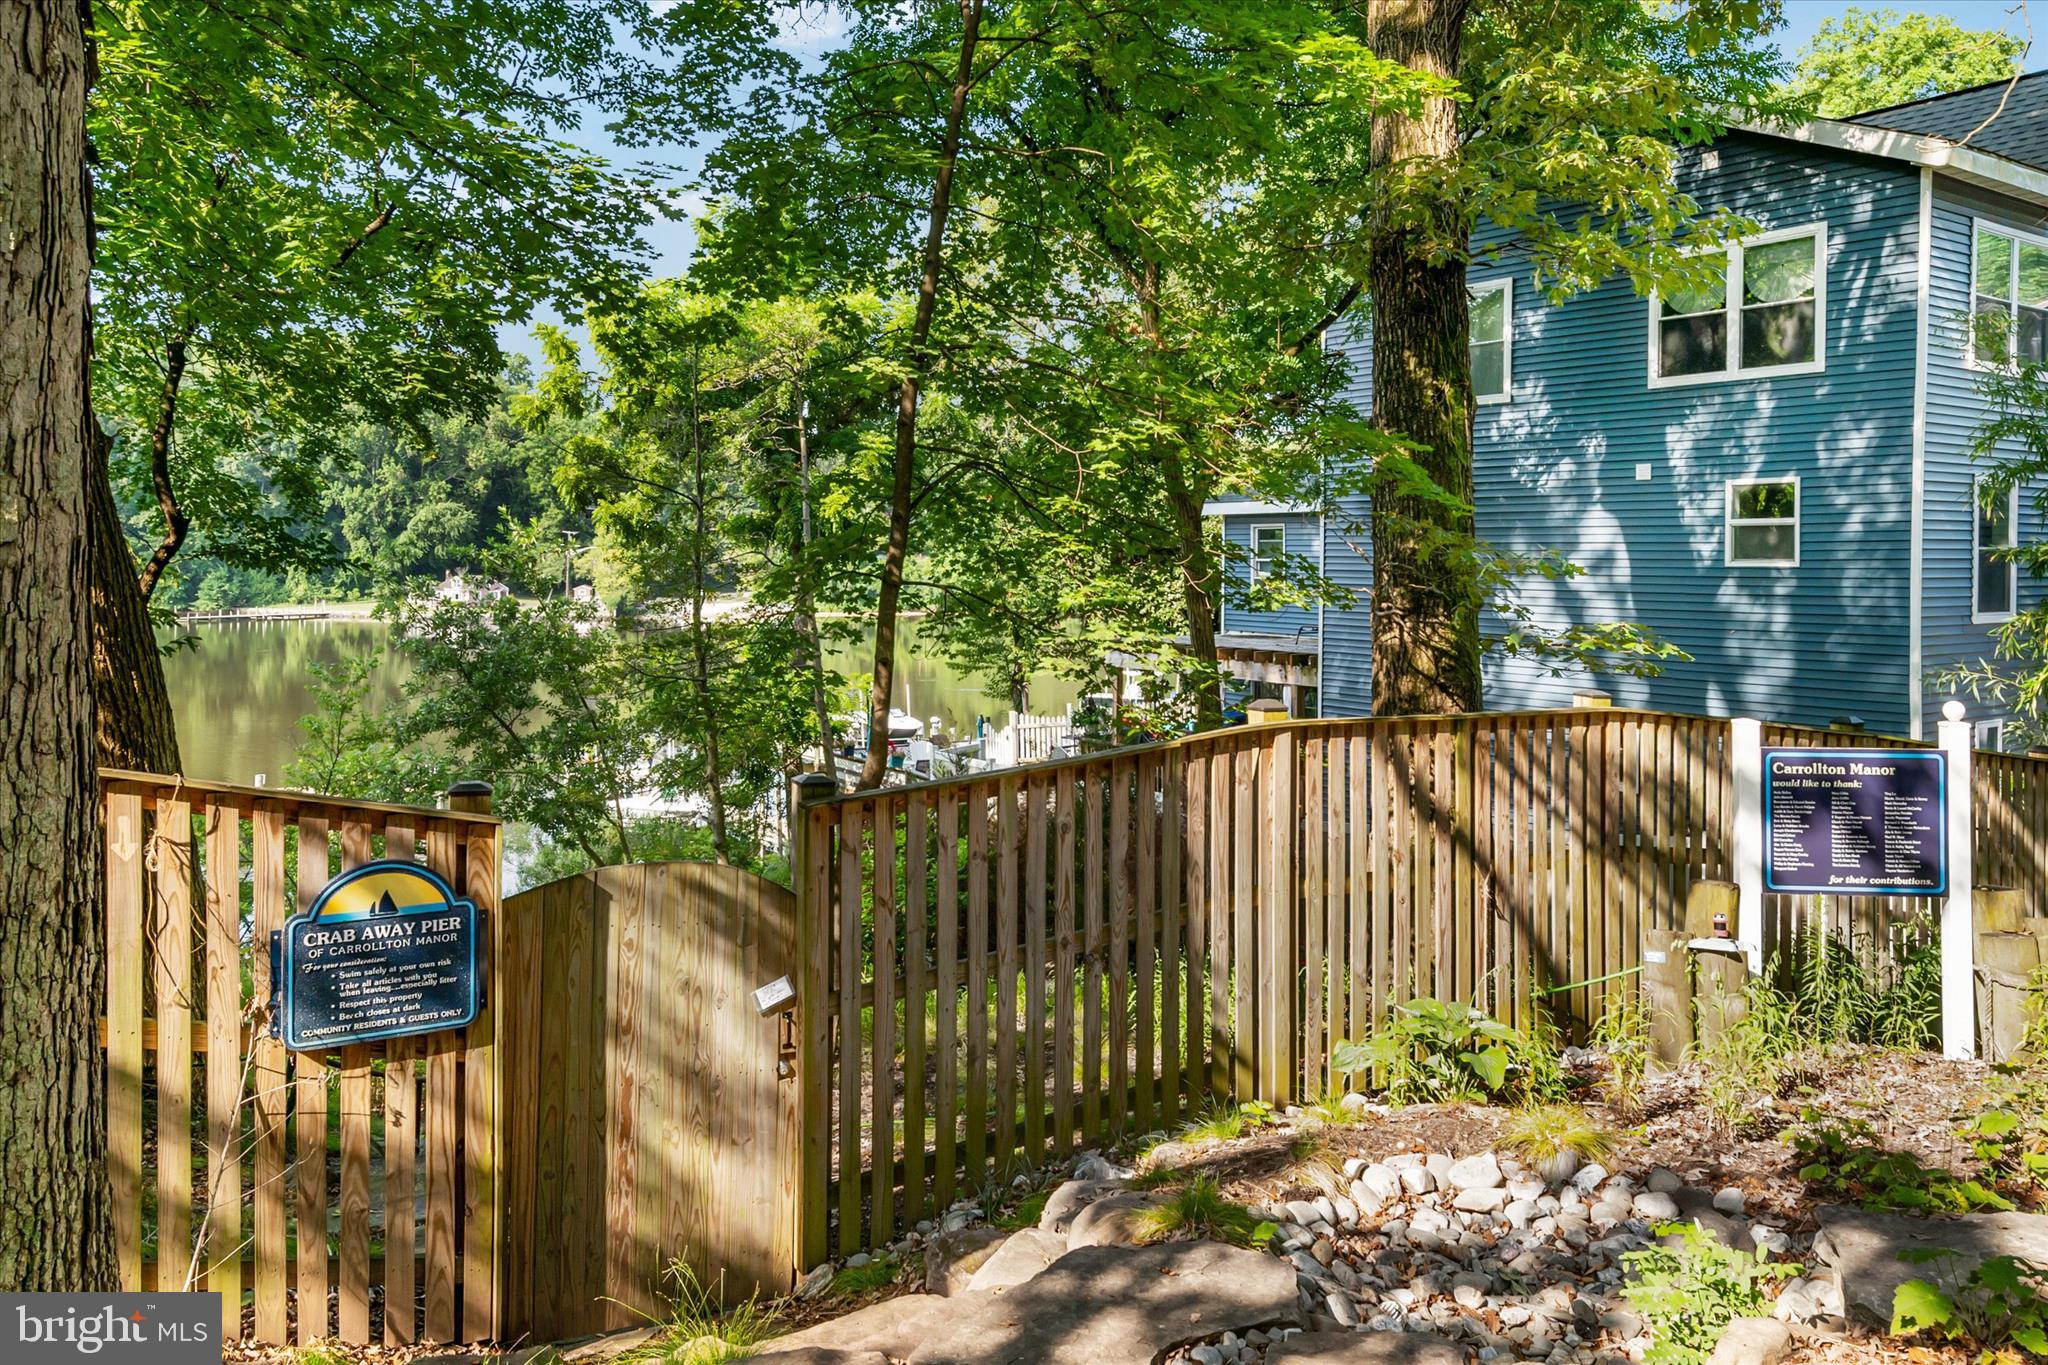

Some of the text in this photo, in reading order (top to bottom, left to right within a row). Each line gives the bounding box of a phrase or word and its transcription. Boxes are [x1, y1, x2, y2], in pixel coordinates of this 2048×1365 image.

[1772, 762, 1896, 776] Carrollton Manor
[1772, 779, 1863, 789] would like to thank:
[1828, 875, 1934, 886] for their contributions.
[303, 917, 462, 947] CRAB AWAY PIER
[308, 933, 458, 959] OF CARROLLTON MANOR
[302, 962, 321, 973] For
[339, 958, 452, 979] Swim safely at your own risk
[339, 971, 438, 991] Take all articles with you
[339, 988, 361, 997] when
[439, 975, 458, 984] litter
[339, 992, 423, 1009] Respect this property
[366, 1008, 391, 1017] closes
[402, 1003, 421, 1011] dark
[301, 1023, 352, 1038] COMMUNITY
[353, 1017, 397, 1030] RESIDENTS
[400, 1013, 407, 1024] &
[408, 1010, 439, 1022] GUESTS
